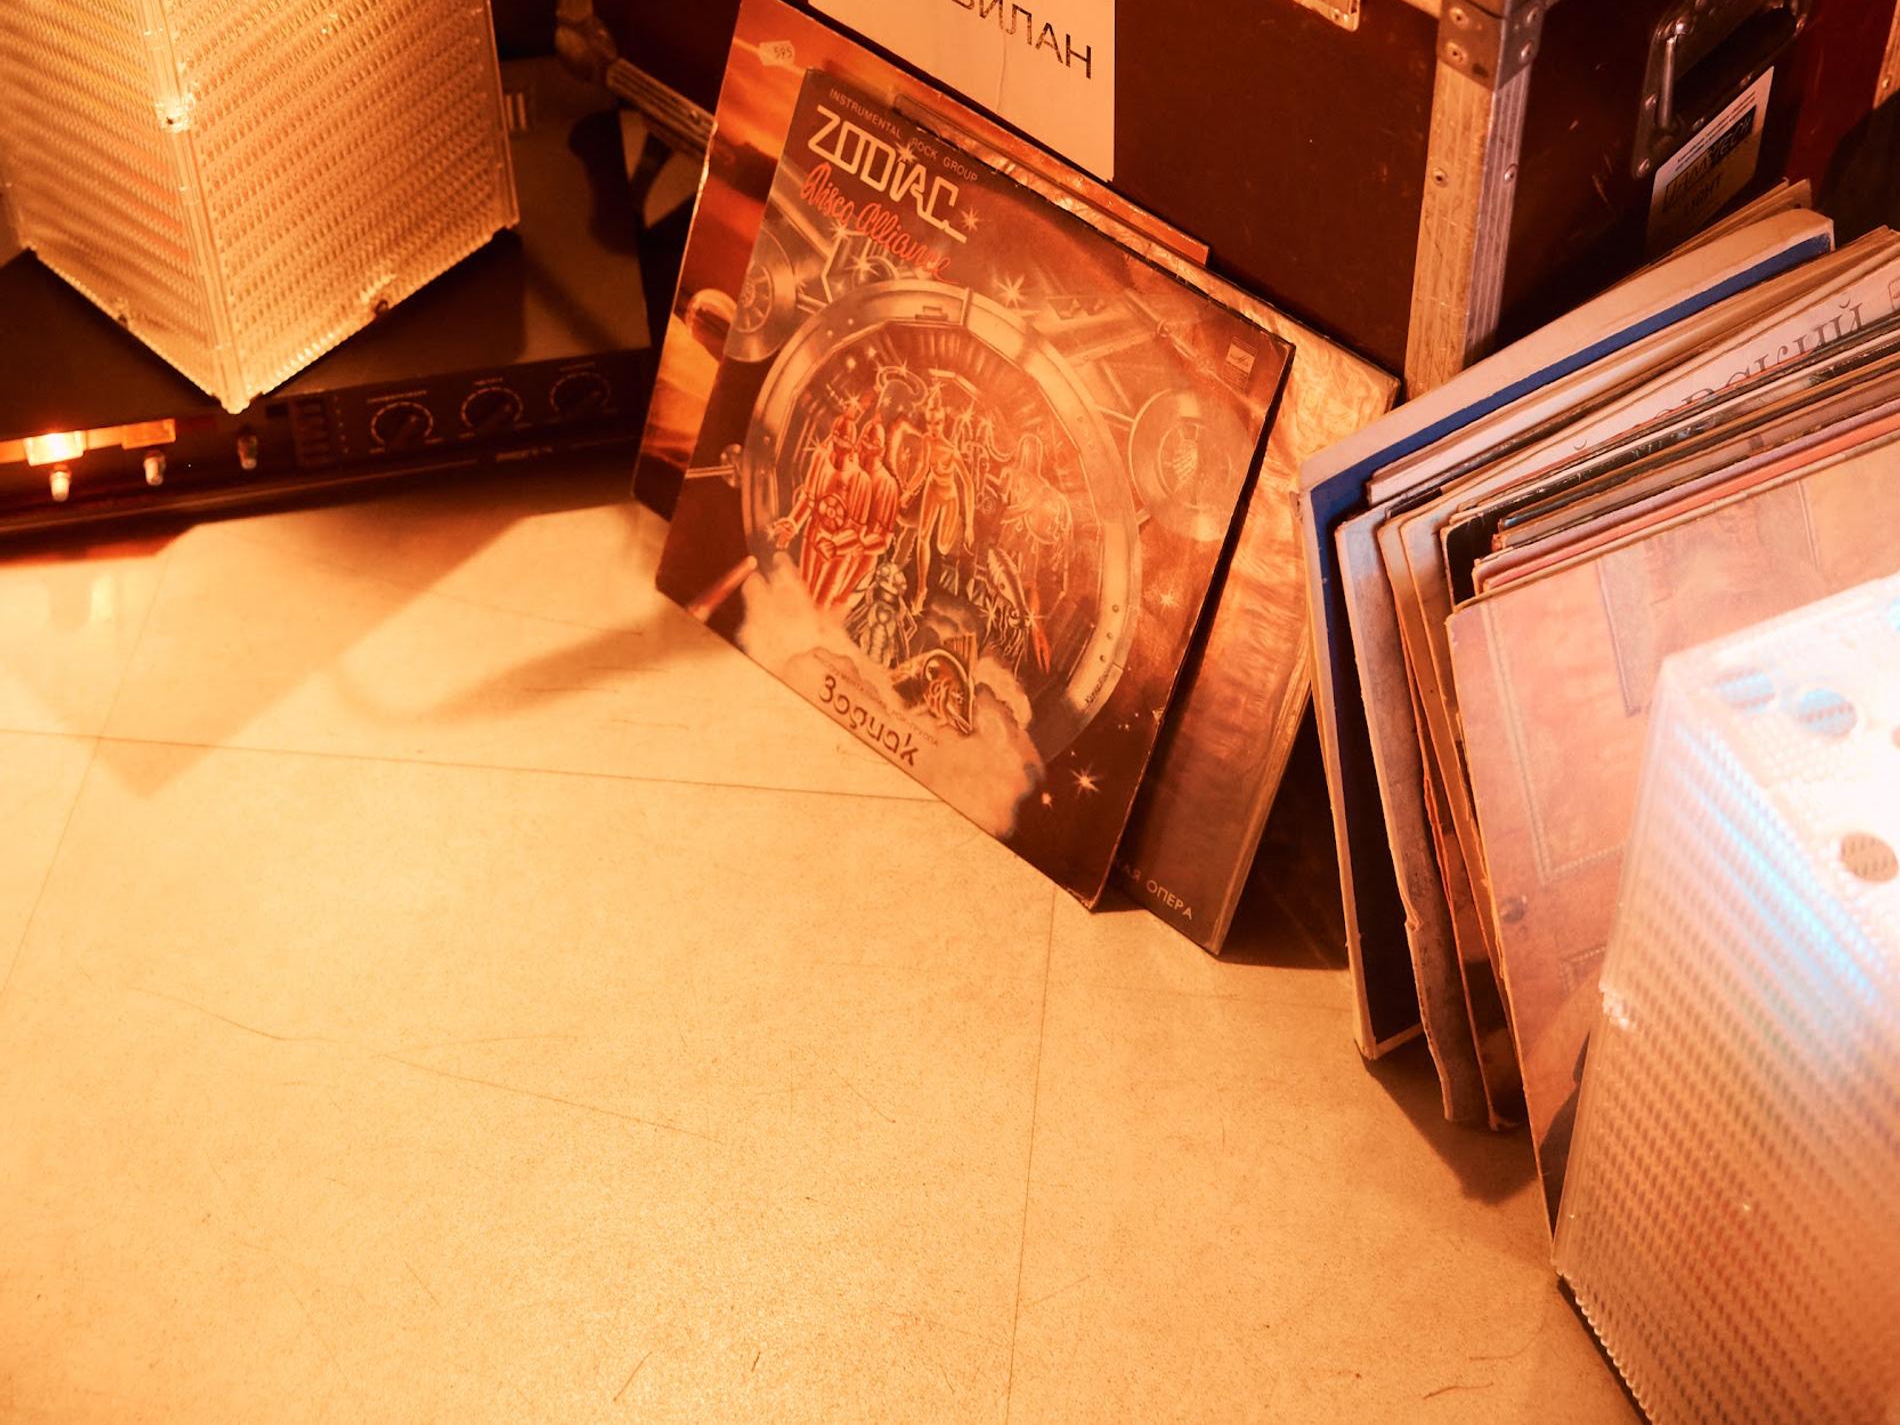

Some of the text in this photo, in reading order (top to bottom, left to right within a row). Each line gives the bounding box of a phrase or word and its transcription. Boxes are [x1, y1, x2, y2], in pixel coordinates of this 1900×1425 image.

[807, 104, 968, 244] ZODIAC
[829, 87, 978, 183] INSTRUMENTAL ROCK GROUP
[801, 161, 855, 225] Disco
[818, 674, 919, 767] Зодиак
[1145, 879, 1193, 921] ОПЕРА
